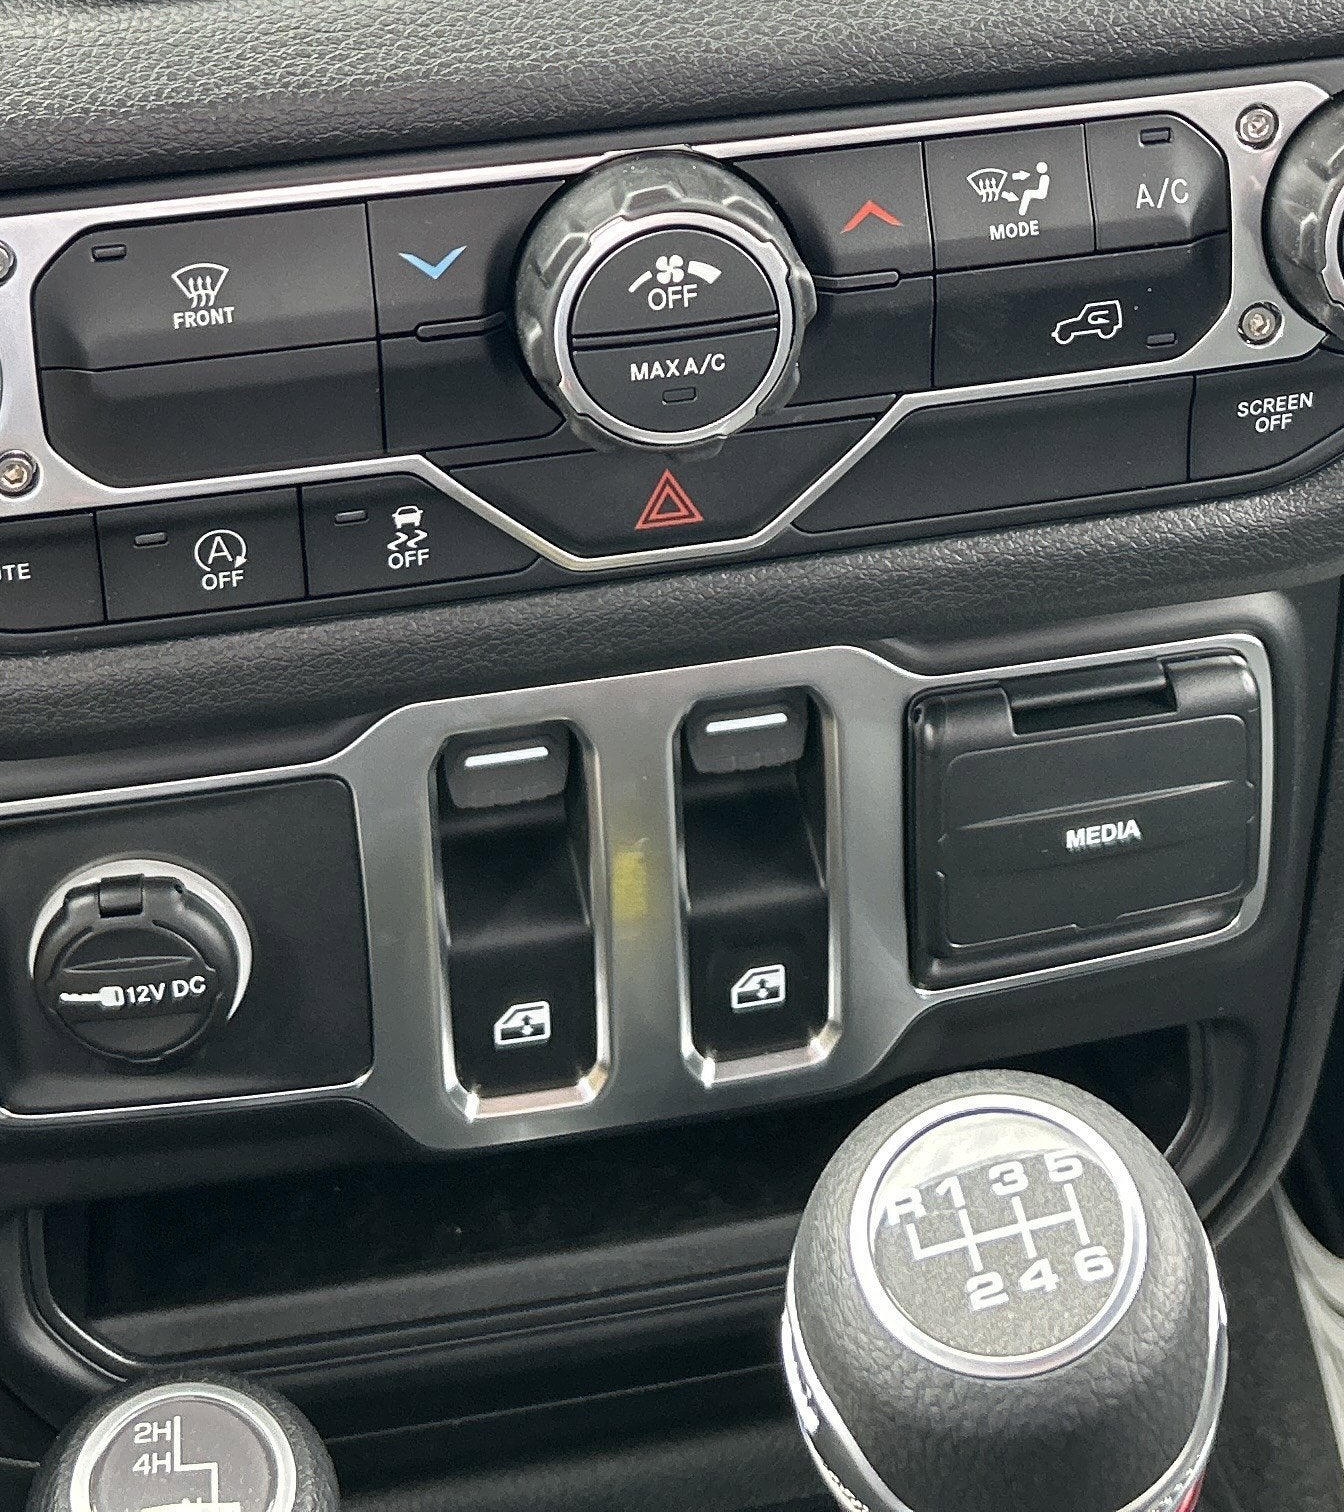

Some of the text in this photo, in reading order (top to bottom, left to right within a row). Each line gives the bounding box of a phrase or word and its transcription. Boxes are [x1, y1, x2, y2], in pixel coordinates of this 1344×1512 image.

[1135, 175, 1191, 209] A/C
[988, 219, 1041, 242] MODE
[647, 283, 698, 312] OFF
[172, 305, 235, 331] FRONT
[629, 352, 727, 382] MAX A/C
[1235, 391, 1314, 420] SCREEN
[1254, 412, 1293, 433] OFF
[387, 547, 430, 571] OFF
[201, 568, 245, 591] OFF
[1064, 817, 1143, 851] MEDIA
[126, 975, 207, 1003] 12V DC
[885, 1151, 1084, 1226] R 1 3 5
[966, 1244, 1115, 1313] 2 4 6
[133, 1420, 172, 1444] 2H
[132, 1451, 172, 1476] 4H
